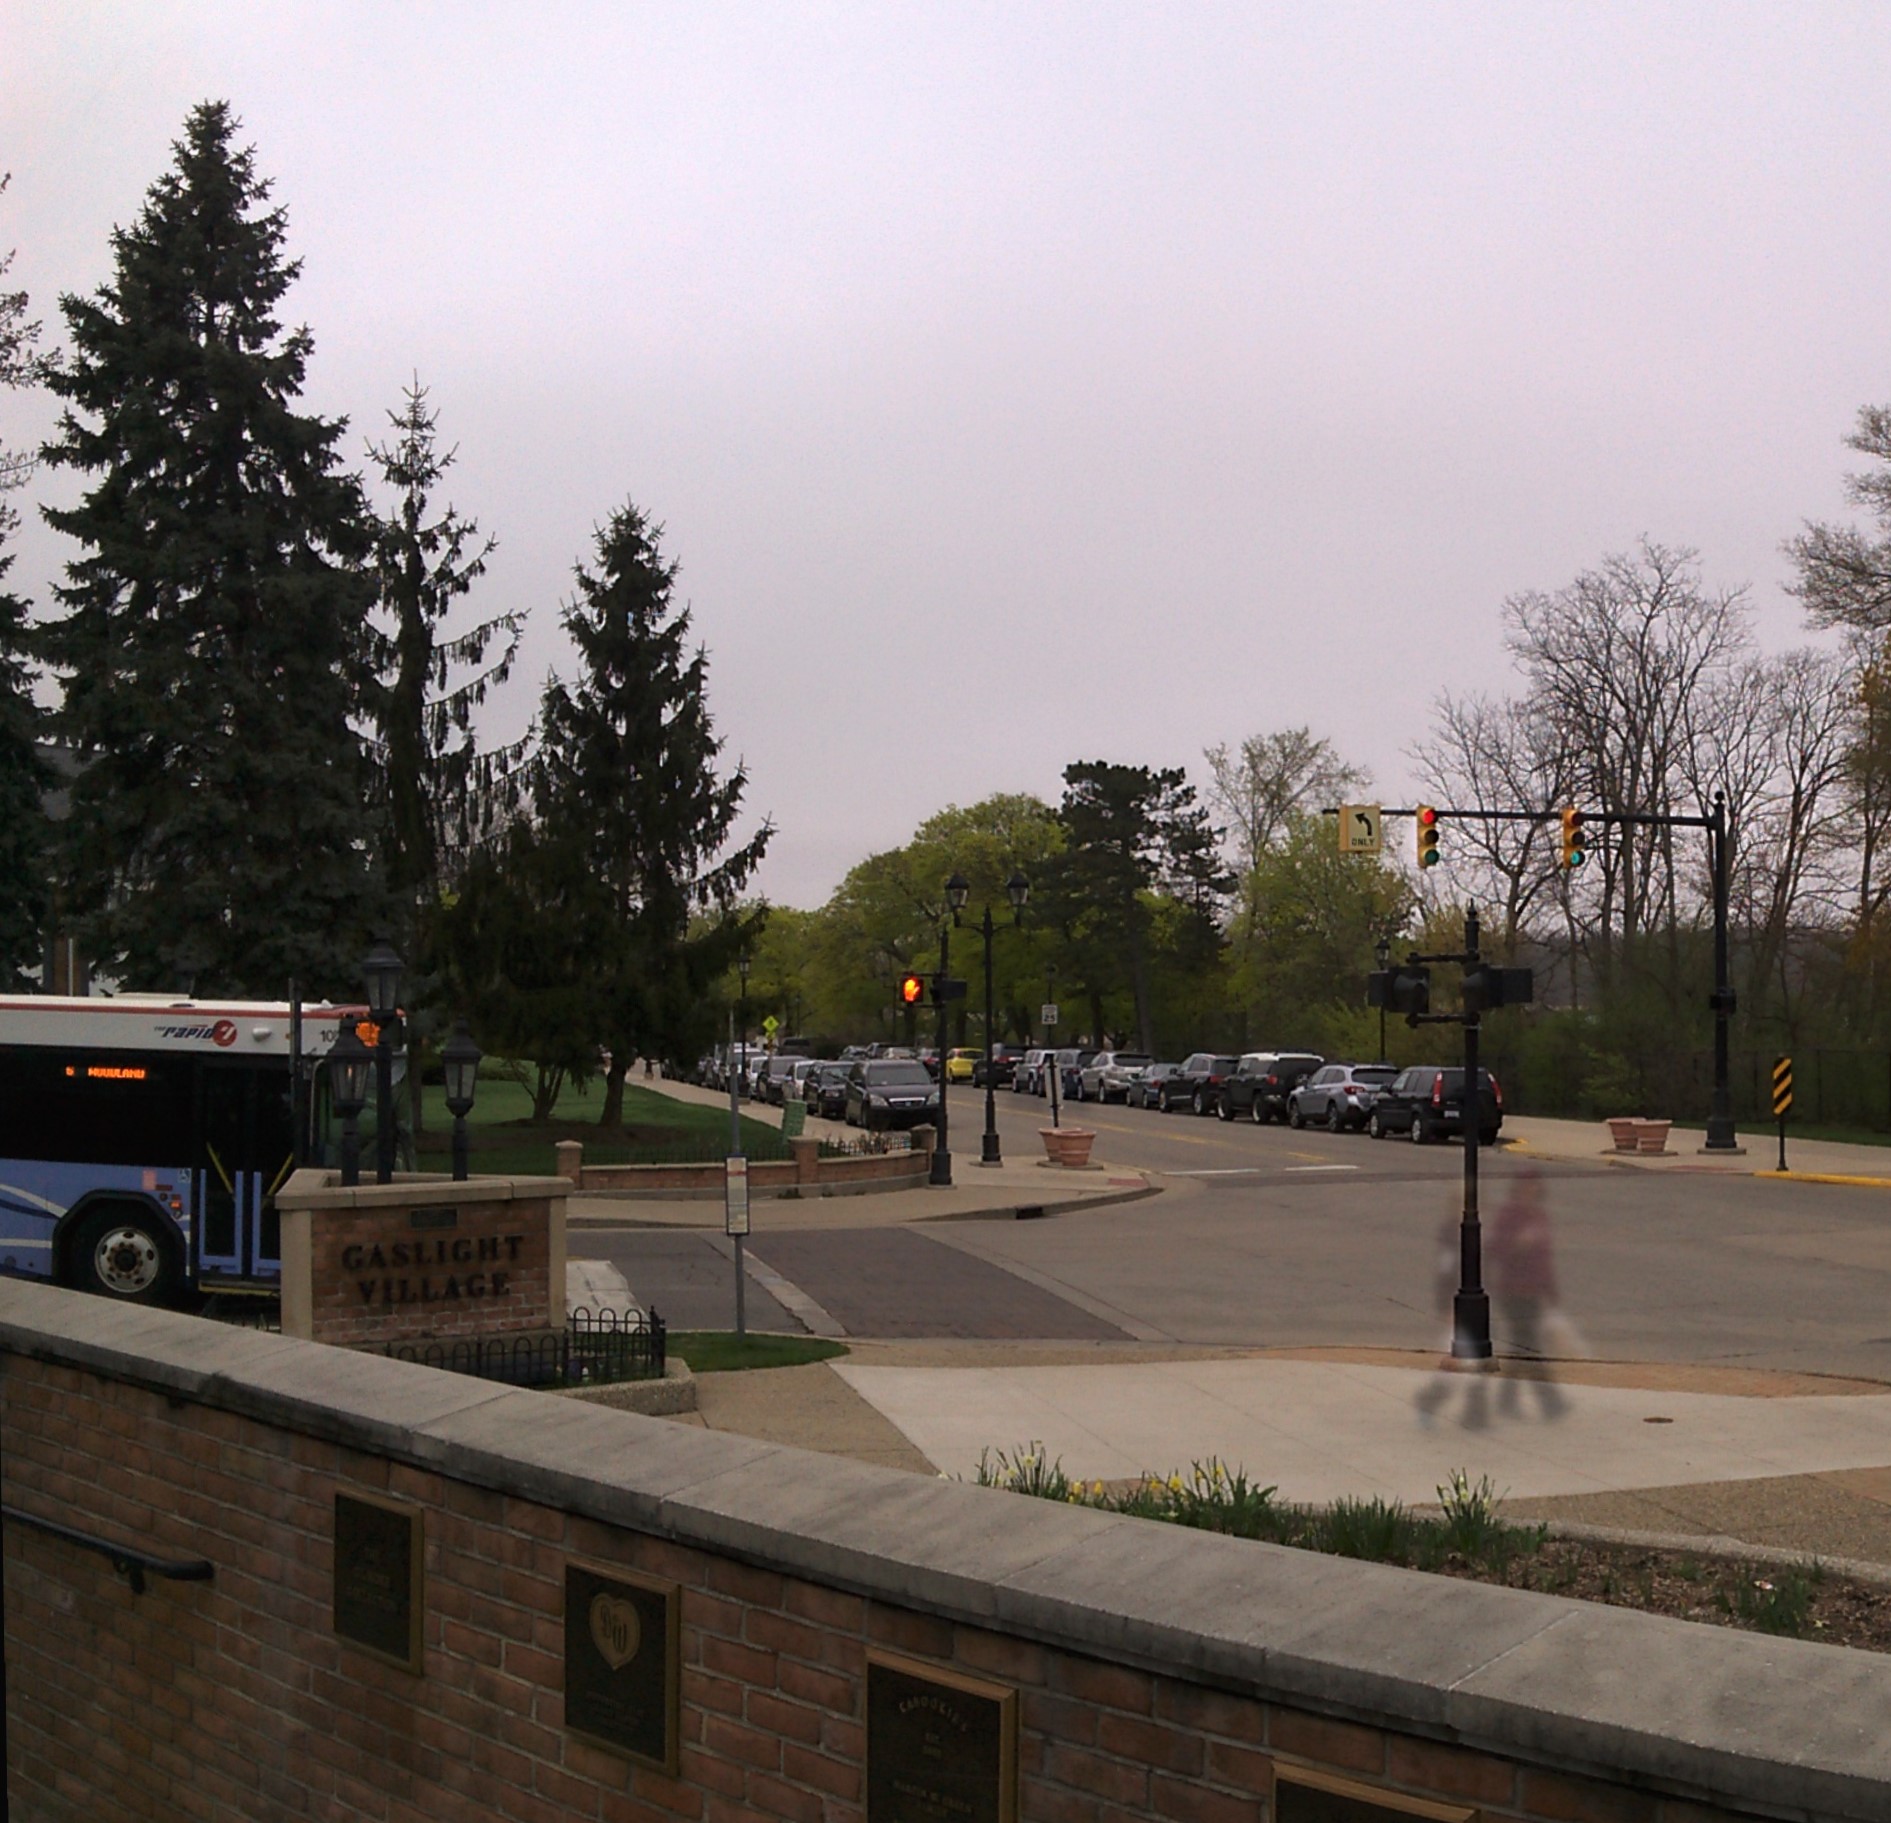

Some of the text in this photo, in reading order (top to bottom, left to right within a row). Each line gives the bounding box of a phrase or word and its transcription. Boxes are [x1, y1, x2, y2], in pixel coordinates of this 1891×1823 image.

[1351, 837, 1375, 846] ONLY
[342, 1236, 522, 1270] GASLIGHT
[358, 1273, 509, 1304] VILLAGE
